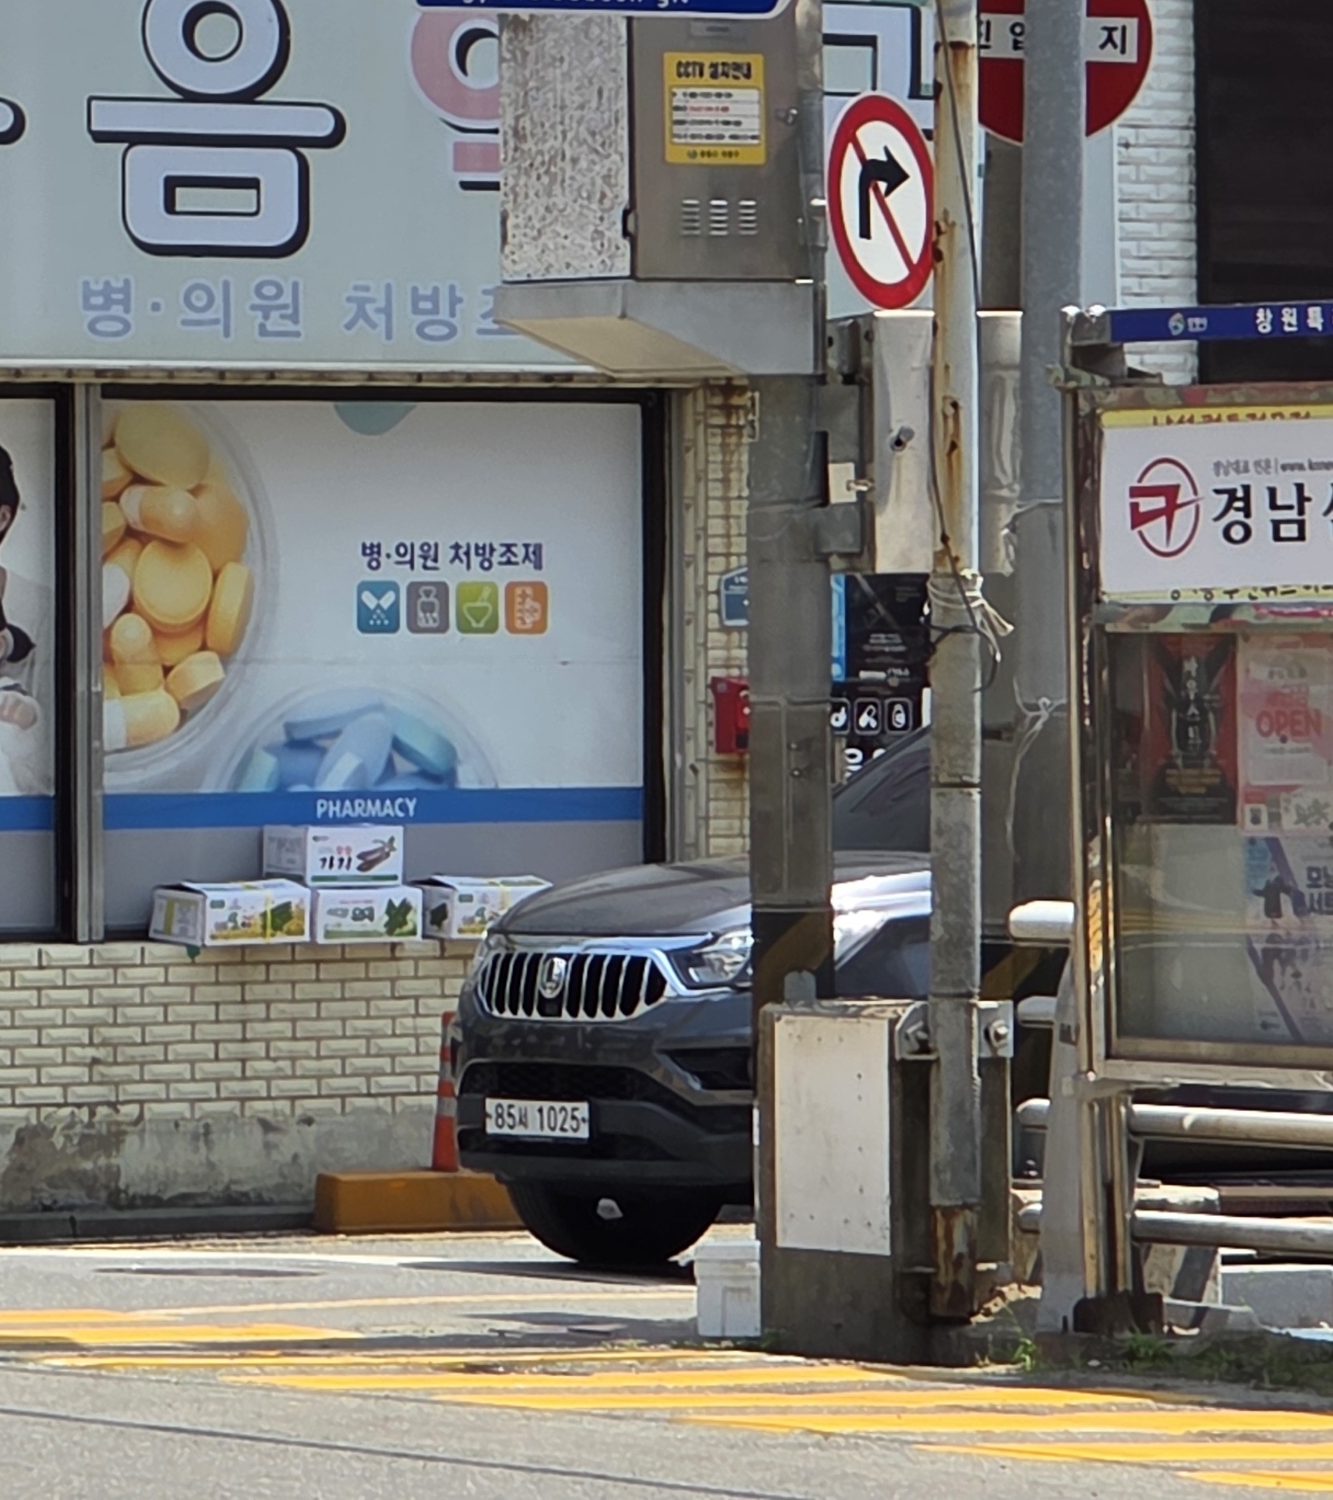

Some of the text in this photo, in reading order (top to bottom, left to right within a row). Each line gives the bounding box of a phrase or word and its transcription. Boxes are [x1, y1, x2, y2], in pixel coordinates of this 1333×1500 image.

[343, 281, 523, 344] 처방
[360, 541, 544, 571] 병·의원 처방조제
[1256, 709, 1322, 738] OPEN
[316, 798, 417, 819] PHARMACY
[537, 1106, 581, 1133] 1025
